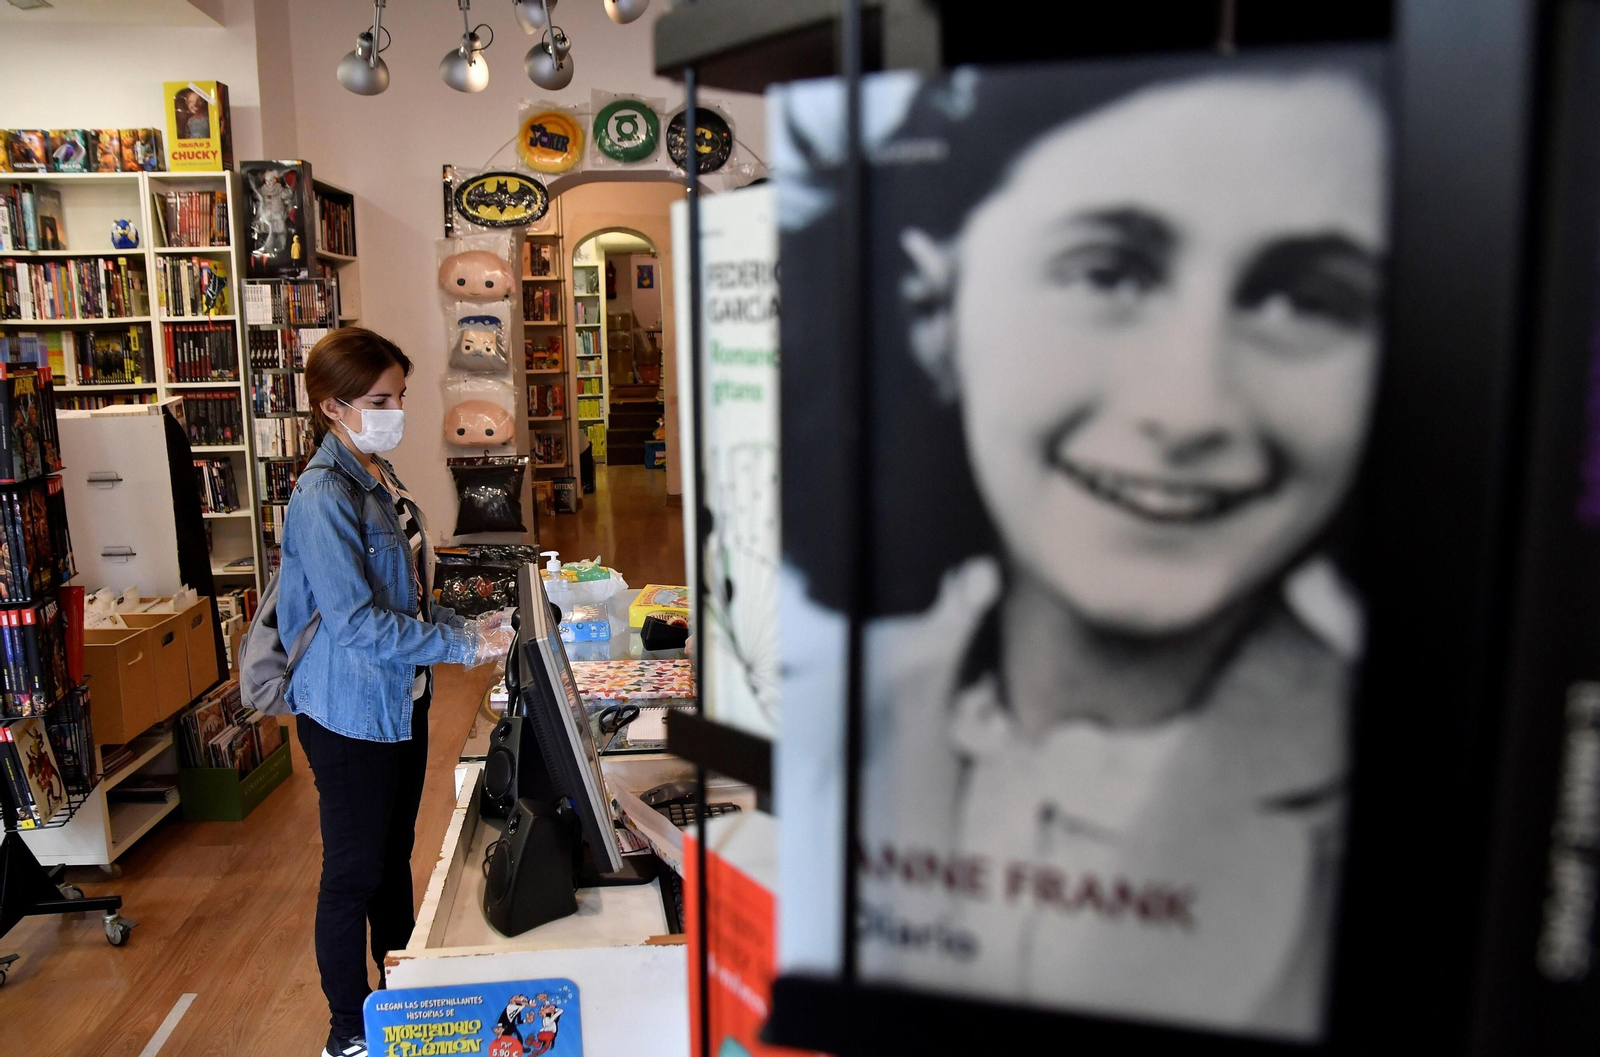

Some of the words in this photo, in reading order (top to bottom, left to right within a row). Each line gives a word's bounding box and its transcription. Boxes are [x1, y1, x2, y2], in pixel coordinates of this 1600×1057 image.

[172, 151, 217, 163] CHUCKY
[1003, 860, 1196, 932] FRANK
[375, 1001, 403, 1012] LLEGAN
[404, 1000, 419, 1009] LAS
[420, 995, 483, 1009] DESTERNILLANTES
[406, 1009, 444, 1020] HISTORIAS
[446, 1008, 455, 1017] DE
